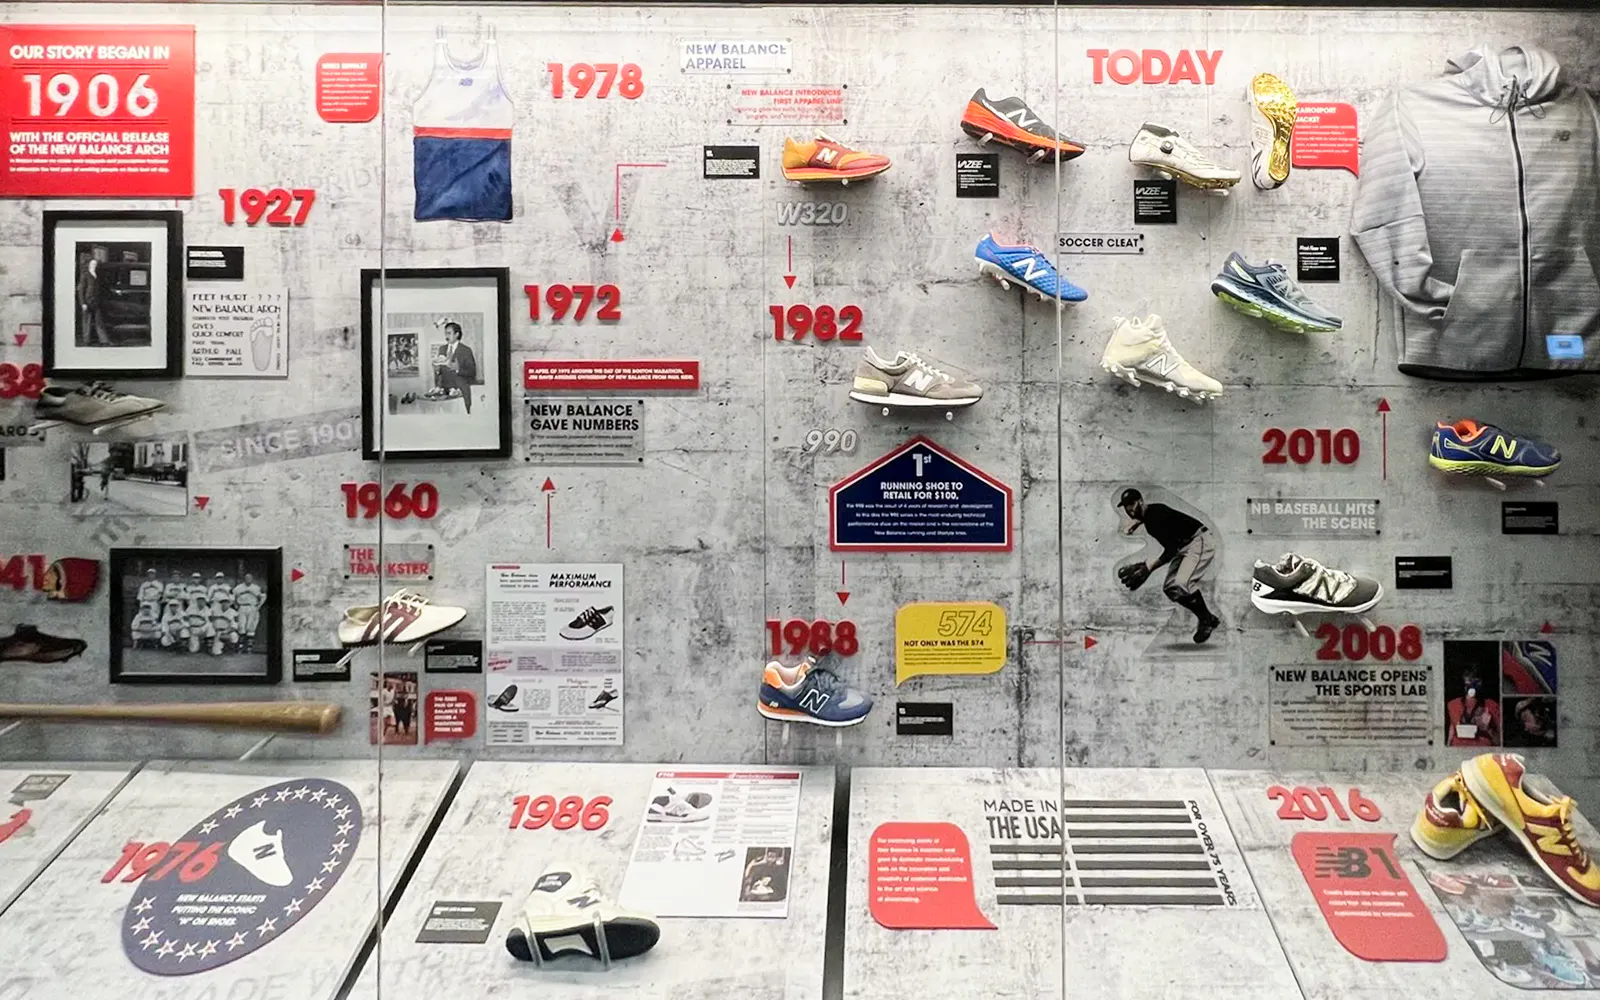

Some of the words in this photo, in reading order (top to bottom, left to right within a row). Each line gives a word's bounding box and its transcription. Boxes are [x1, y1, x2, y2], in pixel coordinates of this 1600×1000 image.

[10, 44, 44, 59] OUR
[47, 44, 95, 59] STORY
[98, 44, 150, 59] BEGAN
[153, 44, 170, 59] IN
[685, 44, 717, 54] NEW
[721, 44, 787, 54] BALANCE
[685, 58, 746, 69] APPAREL
[1087, 49, 1223, 85] TODAY
[547, 62, 645, 99] 1978
[23, 73, 159, 117] 1906
[9, 131, 39, 143] WITH
[43, 131, 63, 143] THE
[66, 131, 119, 143] OFFICIAL
[122, 131, 169, 143] RELEASE
[10, 144, 26, 155] OF
[28, 144, 48, 155] THE
[51, 144, 77, 155] NEW
[79, 144, 133, 155] BALANCE
[135, 144, 169, 155] ARCH
[219, 188, 316, 227] 1927
[776, 201, 848, 226] W320
[1059, 237, 1103, 248] SOCCER
[1107, 237, 1139, 248] CLEAT
[192, 304, 213, 313] NEW
[215, 304, 254, 313] BALANCE
[256, 304, 281, 313] ARCH
[524, 284, 621, 322] 1972
[770, 304, 863, 341] 1982
[530, 404, 561, 416] NEW
[567, 404, 632, 416] BALANCE
[530, 419, 568, 430] GAVE
[573, 419, 639, 430] NUMBERS
[221, 429, 300, 458] SINCE
[309, 421, 361, 445] 190
[805, 428, 858, 451] 990
[1262, 428, 1360, 465] 2010
[880, 481, 923, 490] RUNNING
[925, 481, 949, 490] SHOE
[951, 481, 963, 490] TO
[341, 482, 439, 519] 1960
[883, 491, 912, 500] RETAIL
[914, 491, 932, 500] FOR
[934, 491, 959, 500] $100.
[1251, 503, 1271, 515] NB
[1275, 503, 1339, 515] BASEBALL
[1346, 503, 1375, 515] HITS
[1302, 517, 1328, 530] THE
[1331, 517, 1375, 530] SCENE
[349, 549, 374, 559] THE
[937, 610, 992, 637] 574
[766, 620, 859, 657] 1988
[1315, 623, 1423, 660] 2008
[1275, 670, 1306, 682] NEW
[1311, 670, 1376, 682] BALANCE
[1381, 670, 1427, 682] OPENS
[1315, 685, 1340, 696] THE
[1344, 685, 1397, 696] SPORTS
[1401, 685, 1427, 696] LAB
[508, 795, 613, 831] 1986
[984, 799, 1035, 812] MADE
[1040, 799, 1057, 812] IN
[1267, 786, 1382, 821] 2016
[986, 816, 1022, 839] THE
[1024, 816, 1062, 839] USA
[100, 841, 226, 883] 1976
[1188, 800, 1202, 820] FOR
[1198, 822, 1215, 851] OVER
[1217, 868, 1237, 906] YEARS
[176, 894, 198, 902] NEW
[197, 894, 237, 902] BALANCE
[235, 894, 266, 902] STARTS
[171, 905, 208, 914] PUTTING
[207, 905, 225, 914] THE
[223, 905, 257, 914] ICONIC
